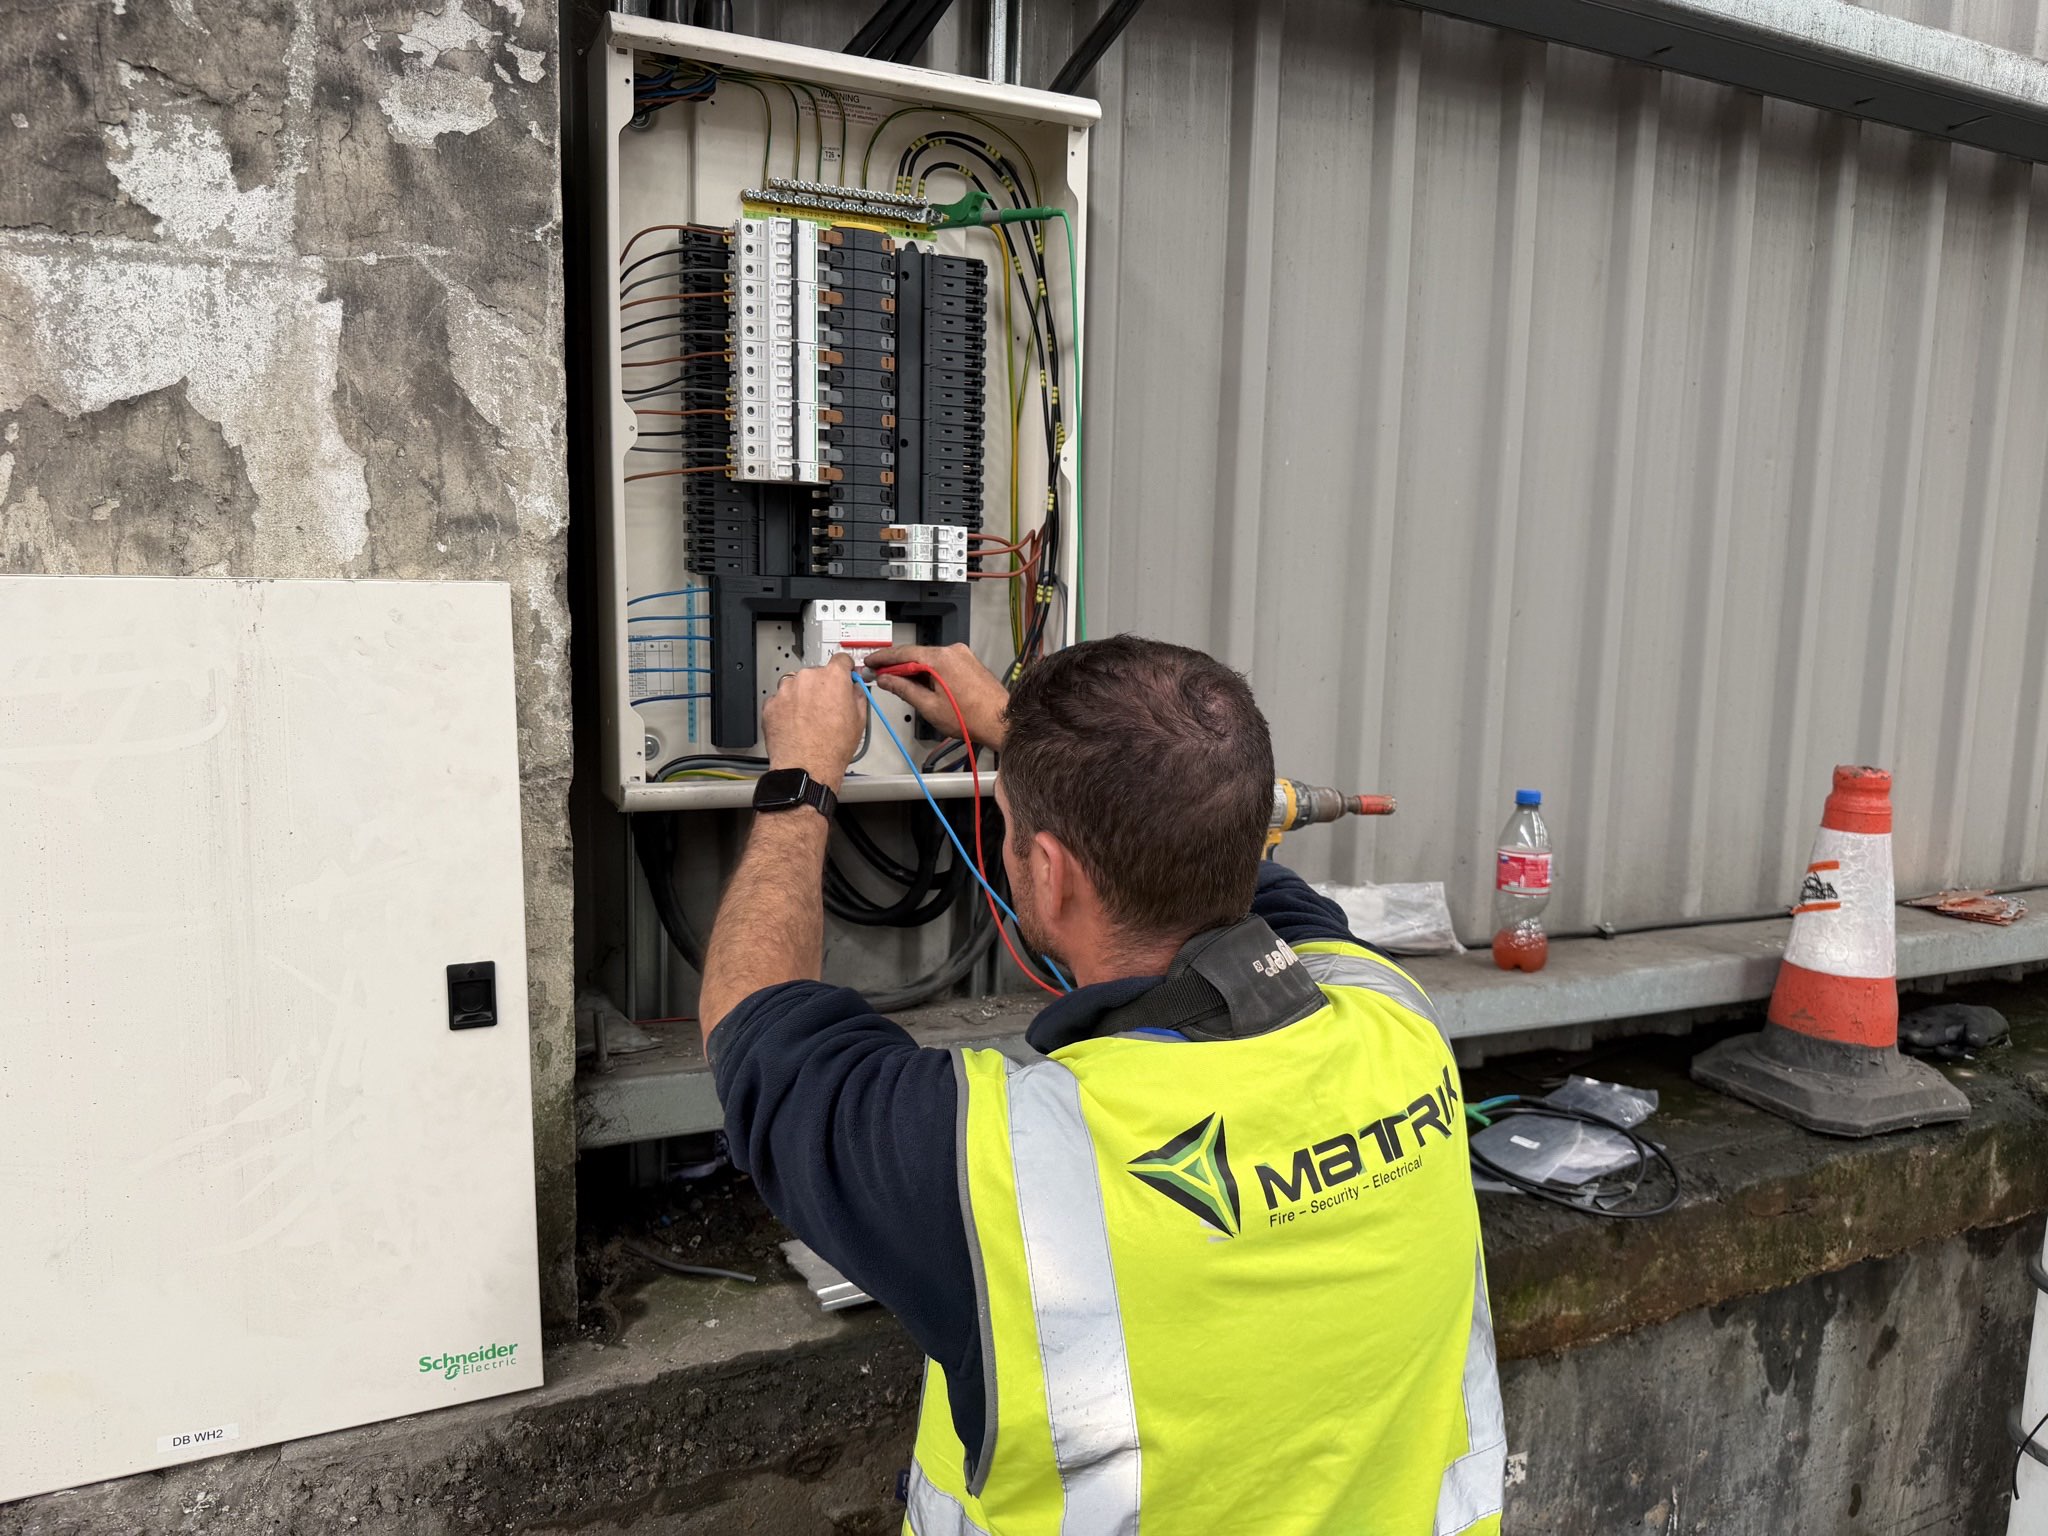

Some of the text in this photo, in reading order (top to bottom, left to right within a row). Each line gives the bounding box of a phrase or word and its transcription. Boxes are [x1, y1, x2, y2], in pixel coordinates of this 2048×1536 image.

[828, 648, 834, 657] N
[1269, 1211, 1295, 1228] Fire
[1310, 1185, 1360, 1214] Security
[1372, 1154, 1423, 1189] Electrical
[418, 1343, 518, 1372] Schneider
[463, 1357, 517, 1375] Electric
[172, 1428, 223, 1447] DB WH2
